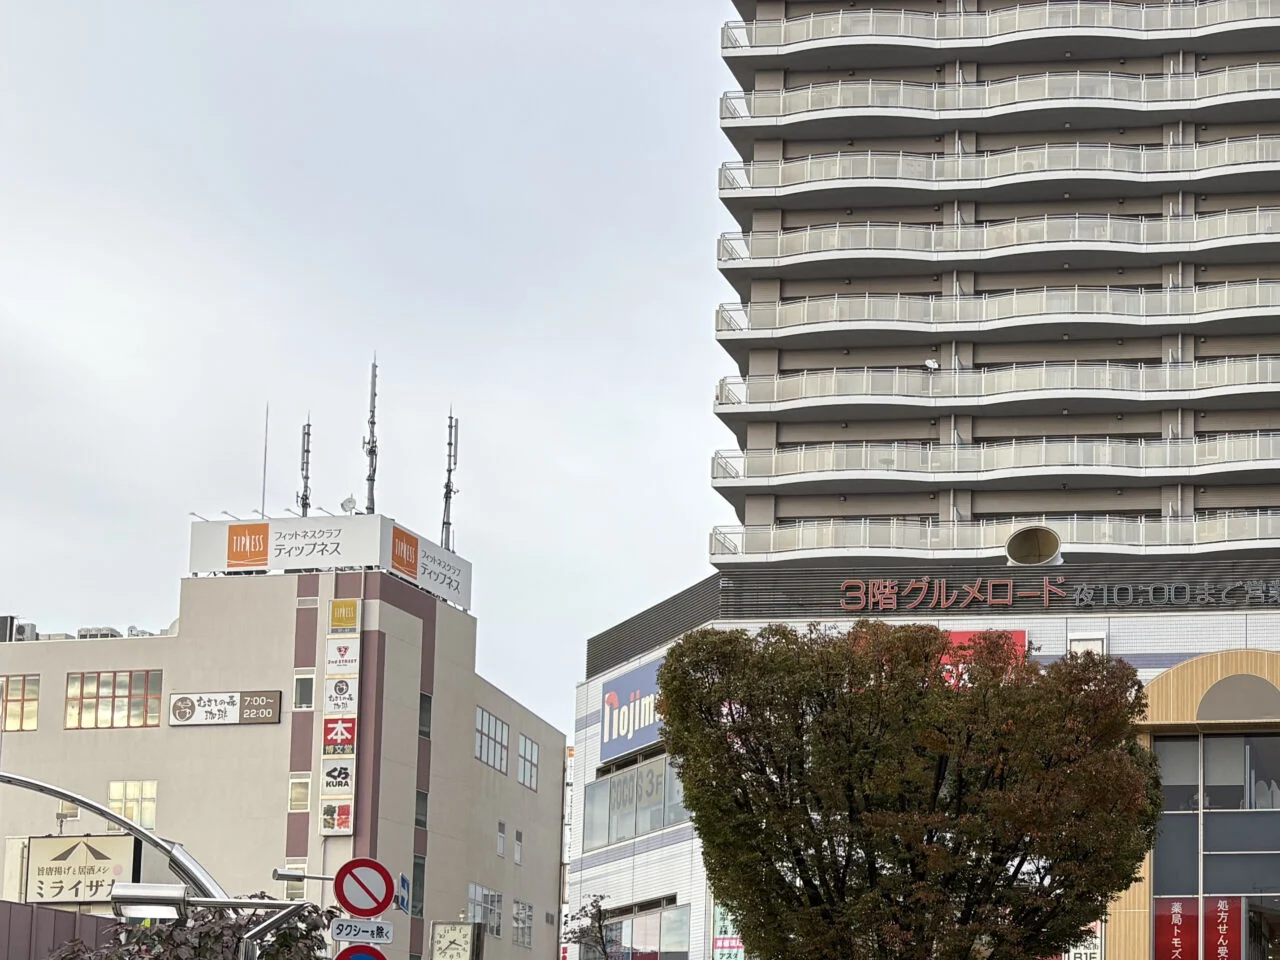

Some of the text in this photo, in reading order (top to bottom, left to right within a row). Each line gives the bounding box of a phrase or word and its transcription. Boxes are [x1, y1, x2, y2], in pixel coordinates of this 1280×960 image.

[274, 528, 342, 541] フィットネスクラブ
[274, 541, 341, 557] ティップネス
[421, 550, 461, 576] フィットネスクラブ
[420, 563, 460, 594] ティップネス
[840, 577, 1066, 610] 3階グルメロード
[196, 695, 237, 708] むさしの森
[204, 708, 229, 720] 珈琲
[243, 709, 273, 718] 22:00
[327, 720, 352, 743] 本
[326, 767, 350, 780] くら
[37, 865, 109, 876] 旨唐揚げと居酒メシ
[336, 924, 390, 939] タクシーを除く
[1170, 902, 1182, 959] 薬局トモズ
